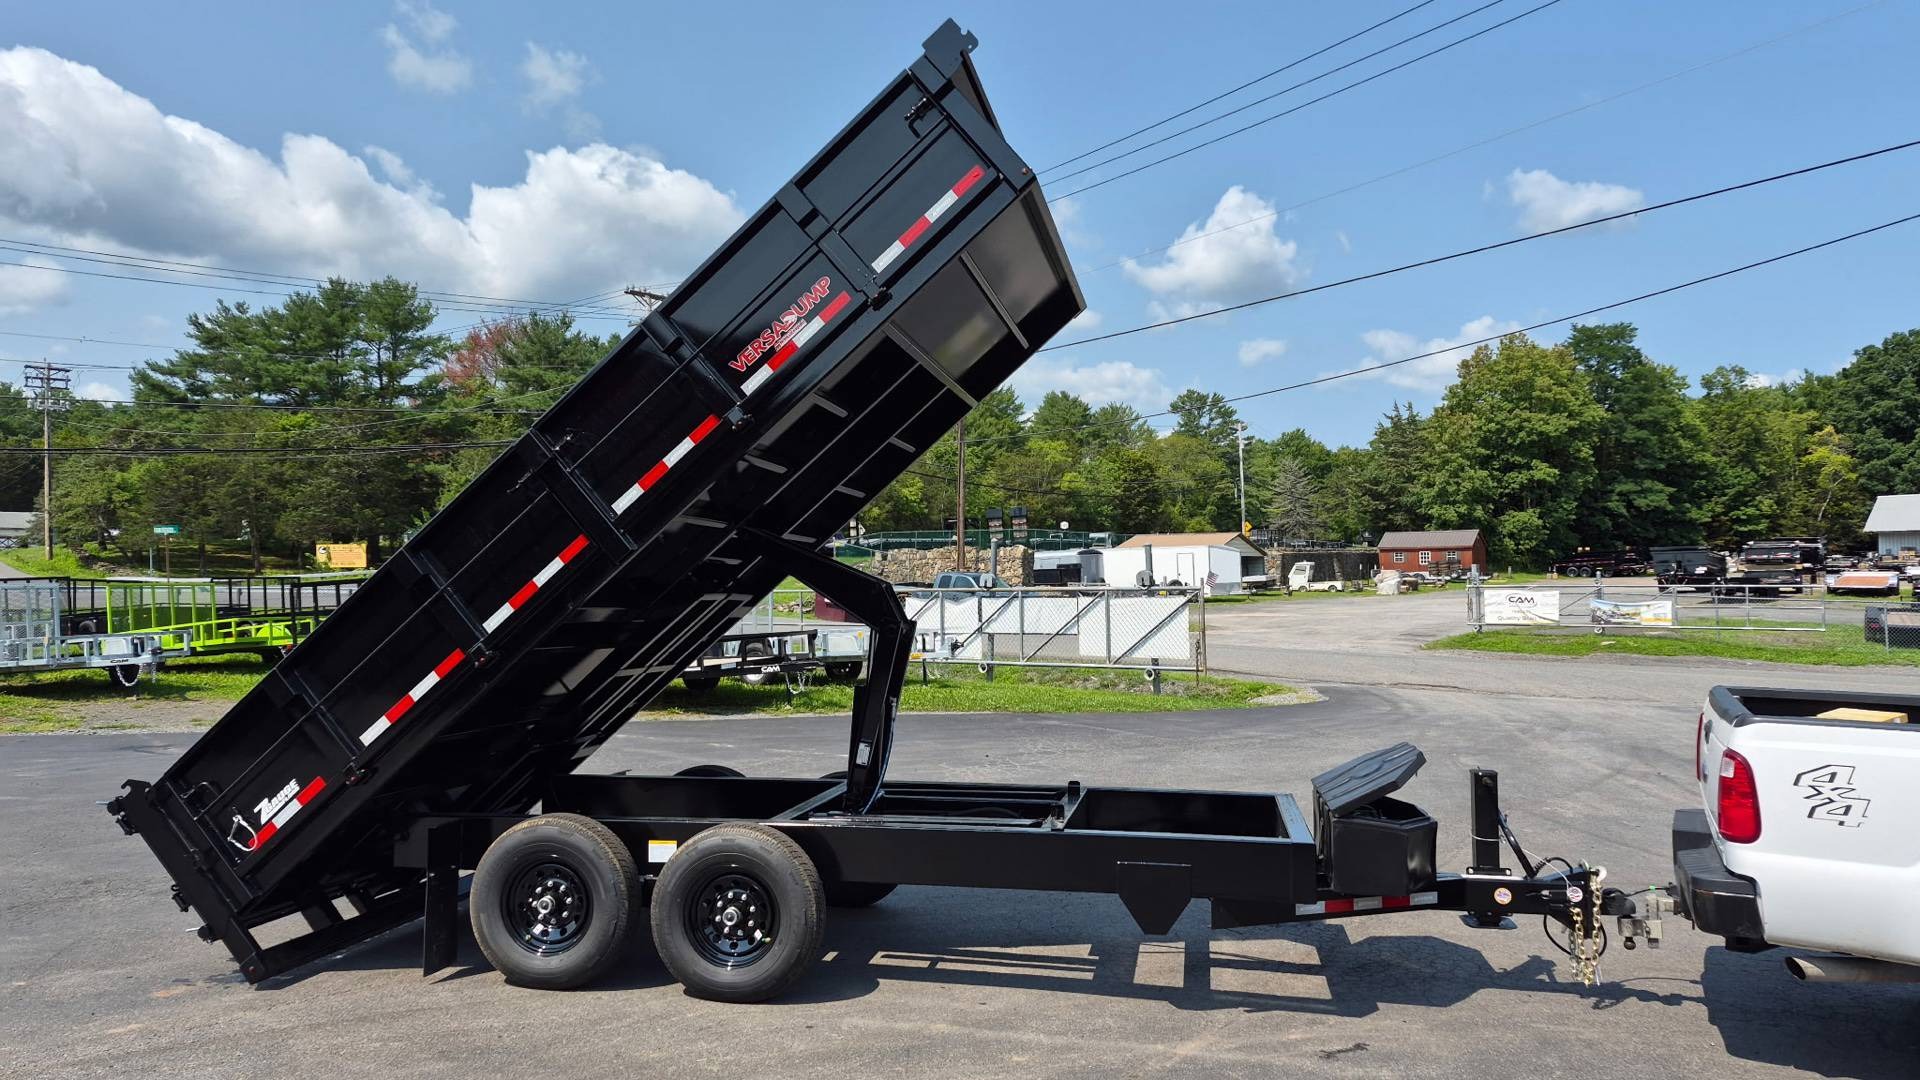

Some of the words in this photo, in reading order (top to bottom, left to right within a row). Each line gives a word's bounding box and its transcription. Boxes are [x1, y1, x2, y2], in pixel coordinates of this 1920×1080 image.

[728, 276, 831, 372] VERSADUMP
[1508, 596, 1535, 604] CAM
[760, 665, 781, 673] CAM
[264, 778, 300, 815] GAUGE
